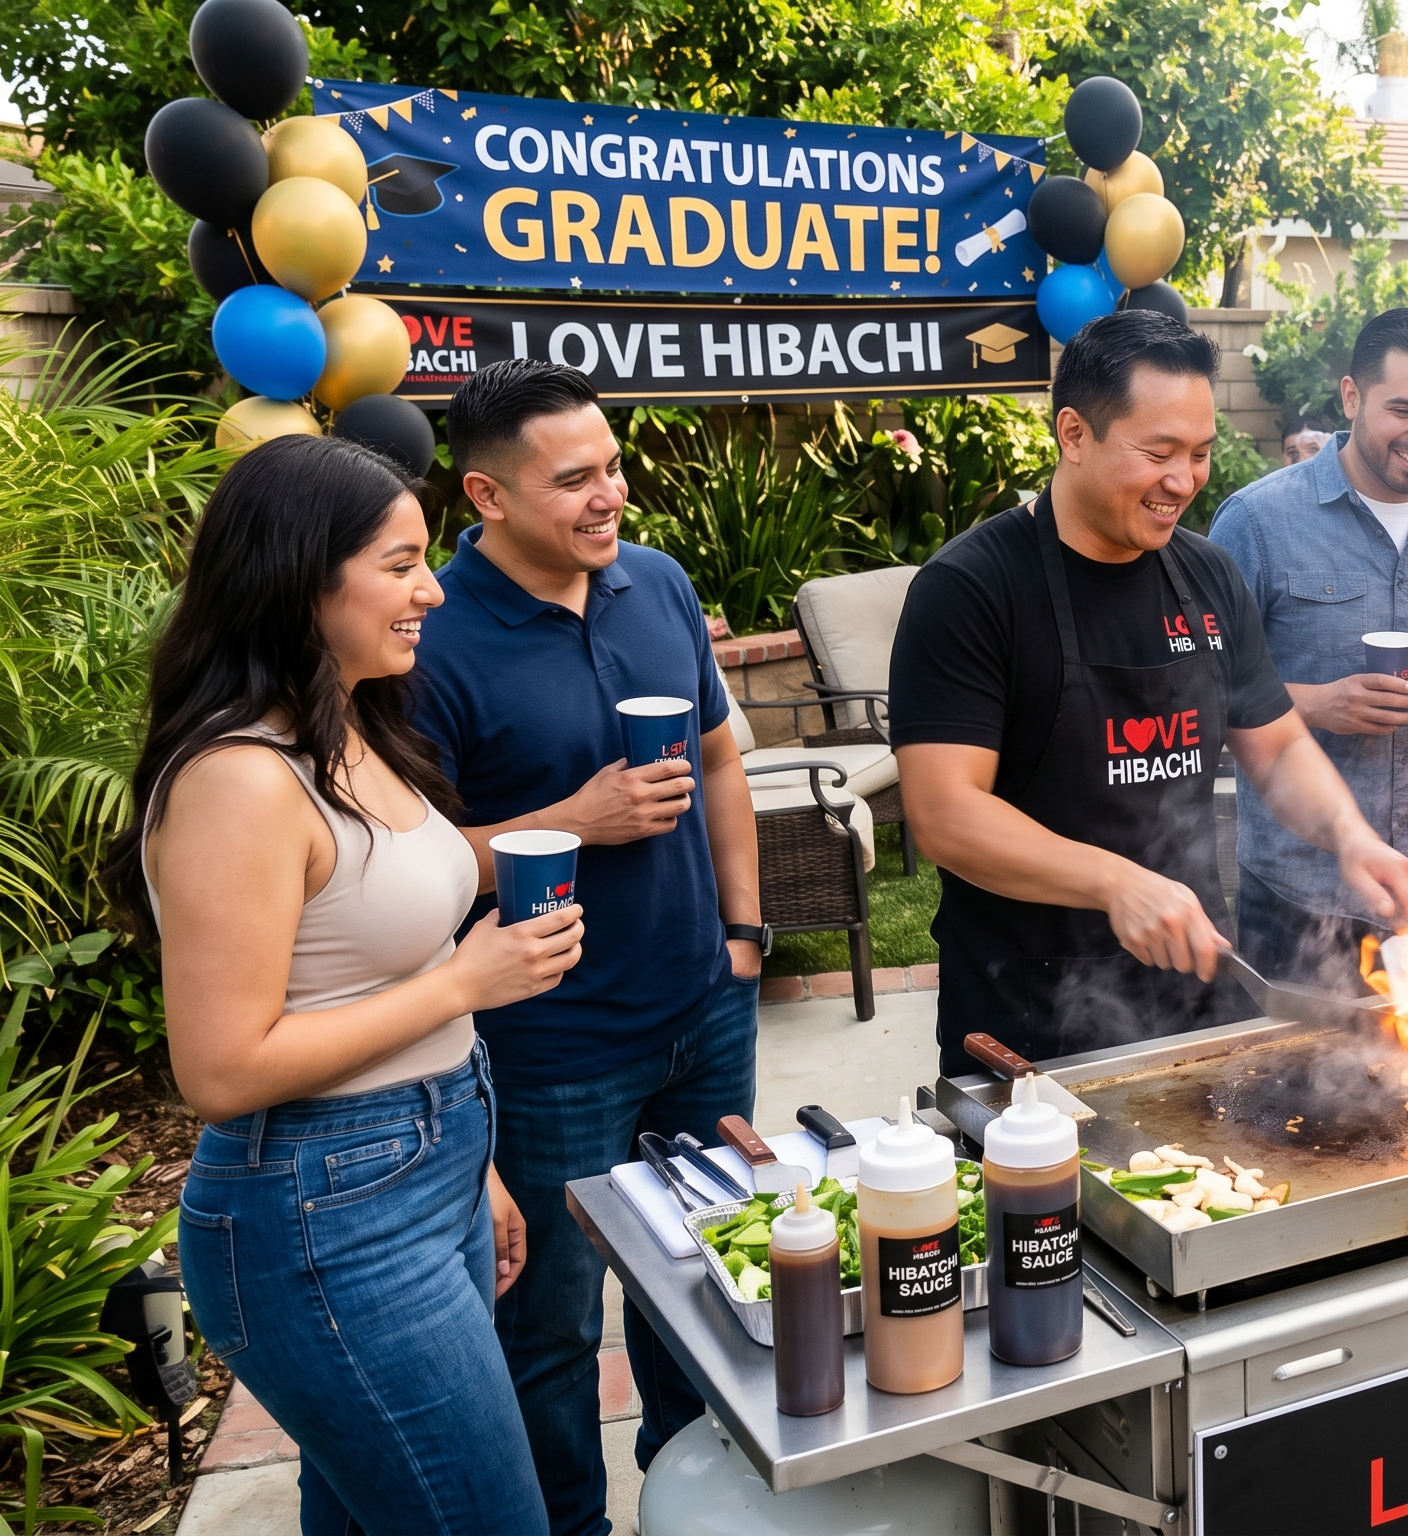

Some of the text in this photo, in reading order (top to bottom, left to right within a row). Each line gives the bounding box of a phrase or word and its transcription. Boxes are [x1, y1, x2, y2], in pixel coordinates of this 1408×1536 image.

[474, 124, 945, 196] CONGRATULATIONS
[483, 187, 941, 275] GRADUATE!
[401, 315, 474, 347] OVE
[700, 322, 944, 378] HIBACHI
[1164, 614, 1220, 636] LOE
[1169, 635, 1223, 653] HIBHI
[1107, 749, 1202, 785] HIBACHI
[1012, 1227, 1079, 1253] HIBATCHI
[888, 1252, 958, 1281] HIBATCHI
[1021, 1246, 1074, 1269] SAUCE
[899, 1272, 953, 1297] SAUCE
